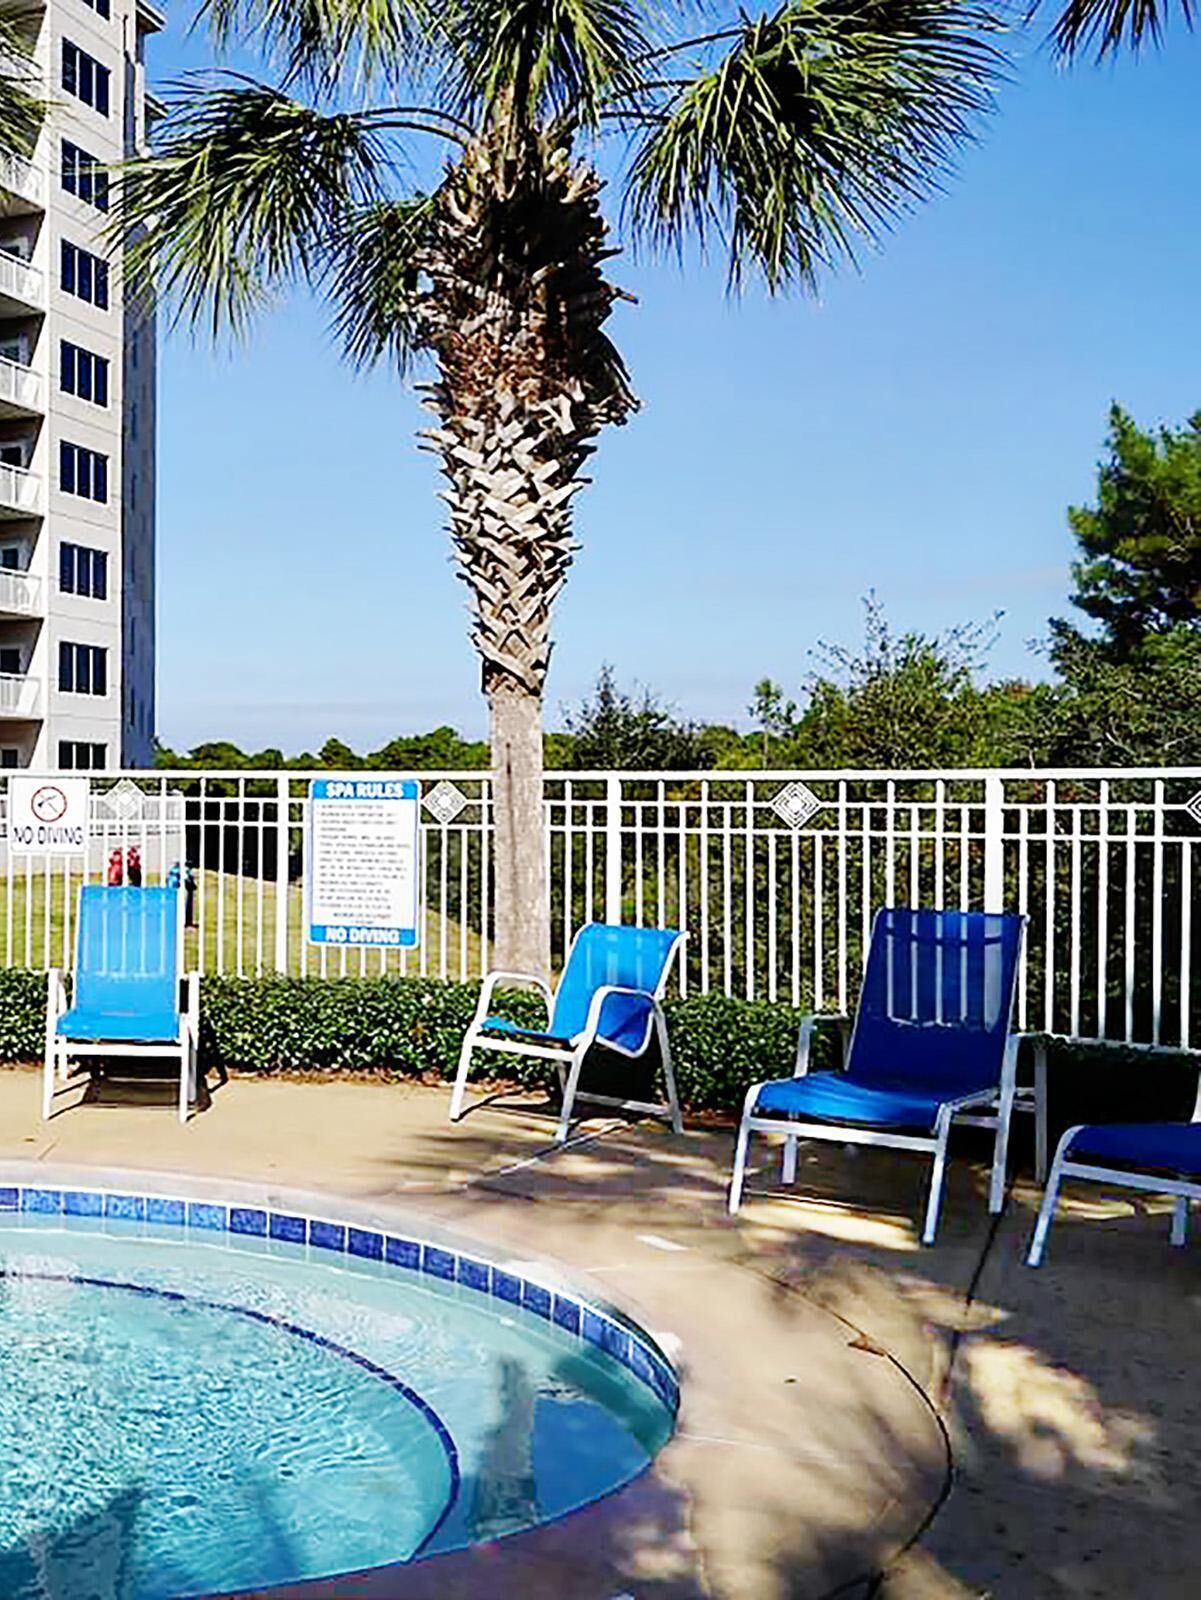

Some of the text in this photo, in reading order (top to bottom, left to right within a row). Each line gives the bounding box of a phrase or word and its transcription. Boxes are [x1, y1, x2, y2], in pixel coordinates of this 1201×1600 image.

[326, 782, 404, 798] SPA RULES
[13, 825, 84, 845] NO DIVING
[325, 928, 400, 944] NO DIVING
